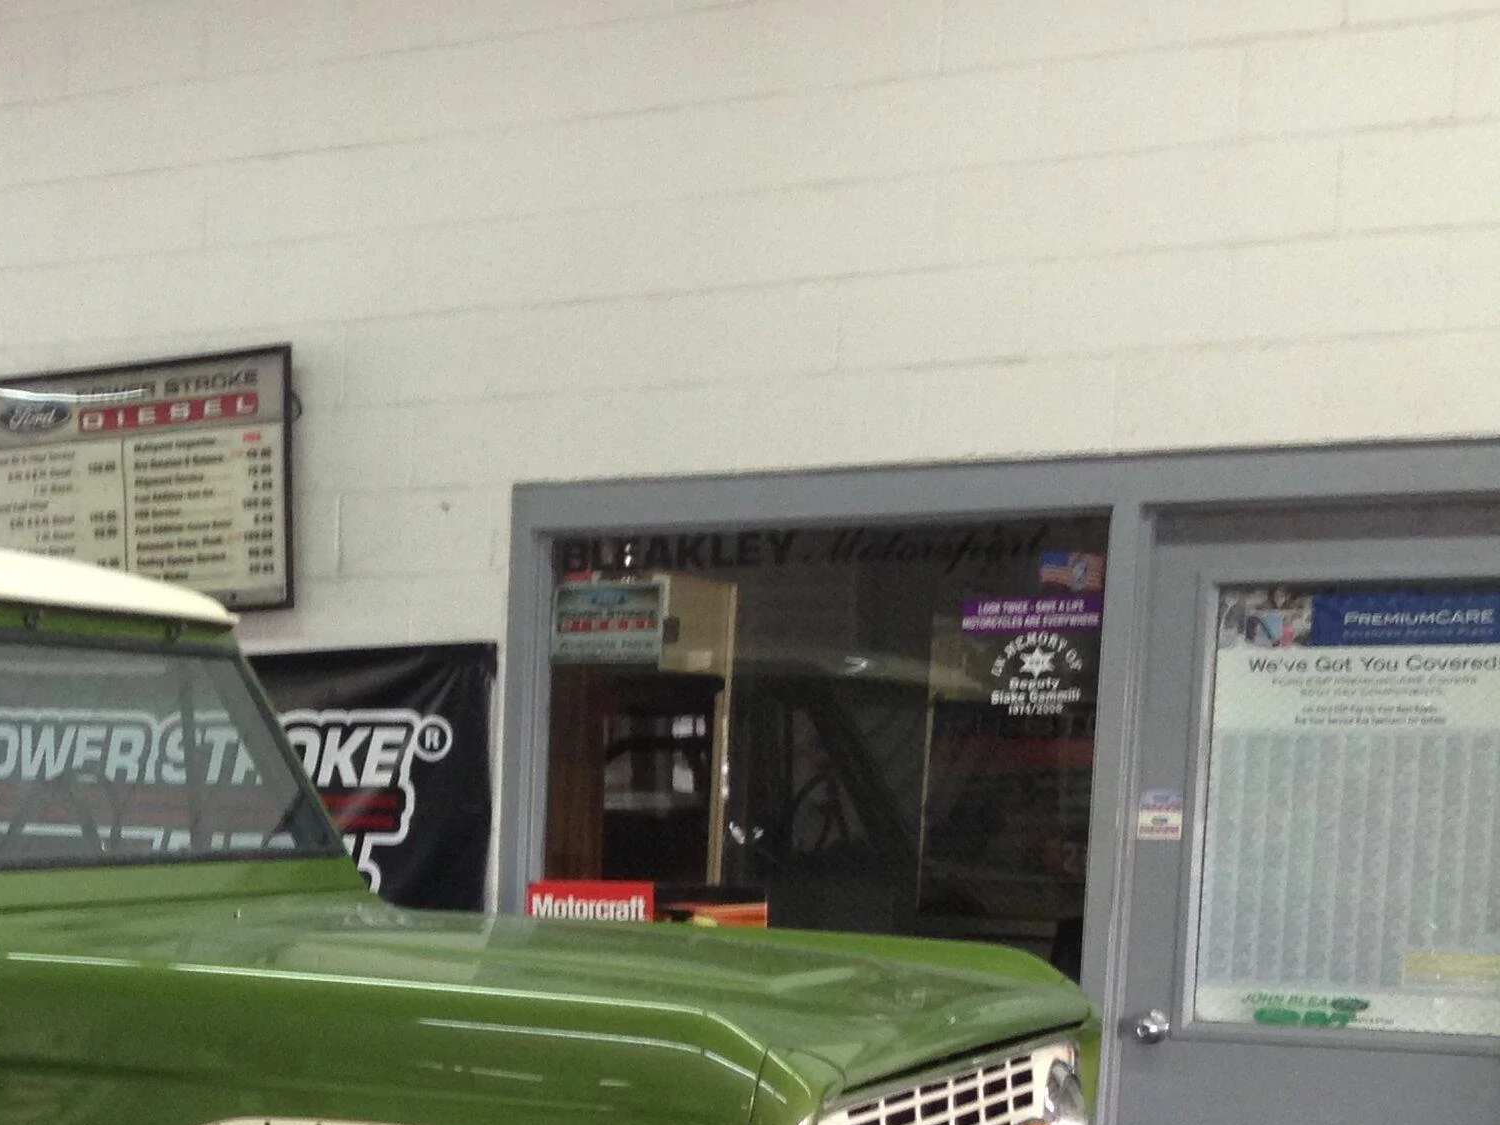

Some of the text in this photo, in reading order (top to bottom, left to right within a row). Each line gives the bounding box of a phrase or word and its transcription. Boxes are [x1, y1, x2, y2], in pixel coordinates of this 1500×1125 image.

[164, 368, 258, 396] STROKE
[7, 404, 57, 432] Ford
[80, 395, 257, 432] DIESEL
[1344, 608, 1495, 626] PREMIUMCARE
[1004, 631, 1068, 659] MEMORY
[1249, 658, 1308, 673] We've
[1315, 655, 1353, 673] Got
[1361, 655, 1399, 672] You
[991, 690, 1026, 705] Blake
[1009, 676, 1061, 691] Deputy
[532, 893, 646, 922] Motorcraft
